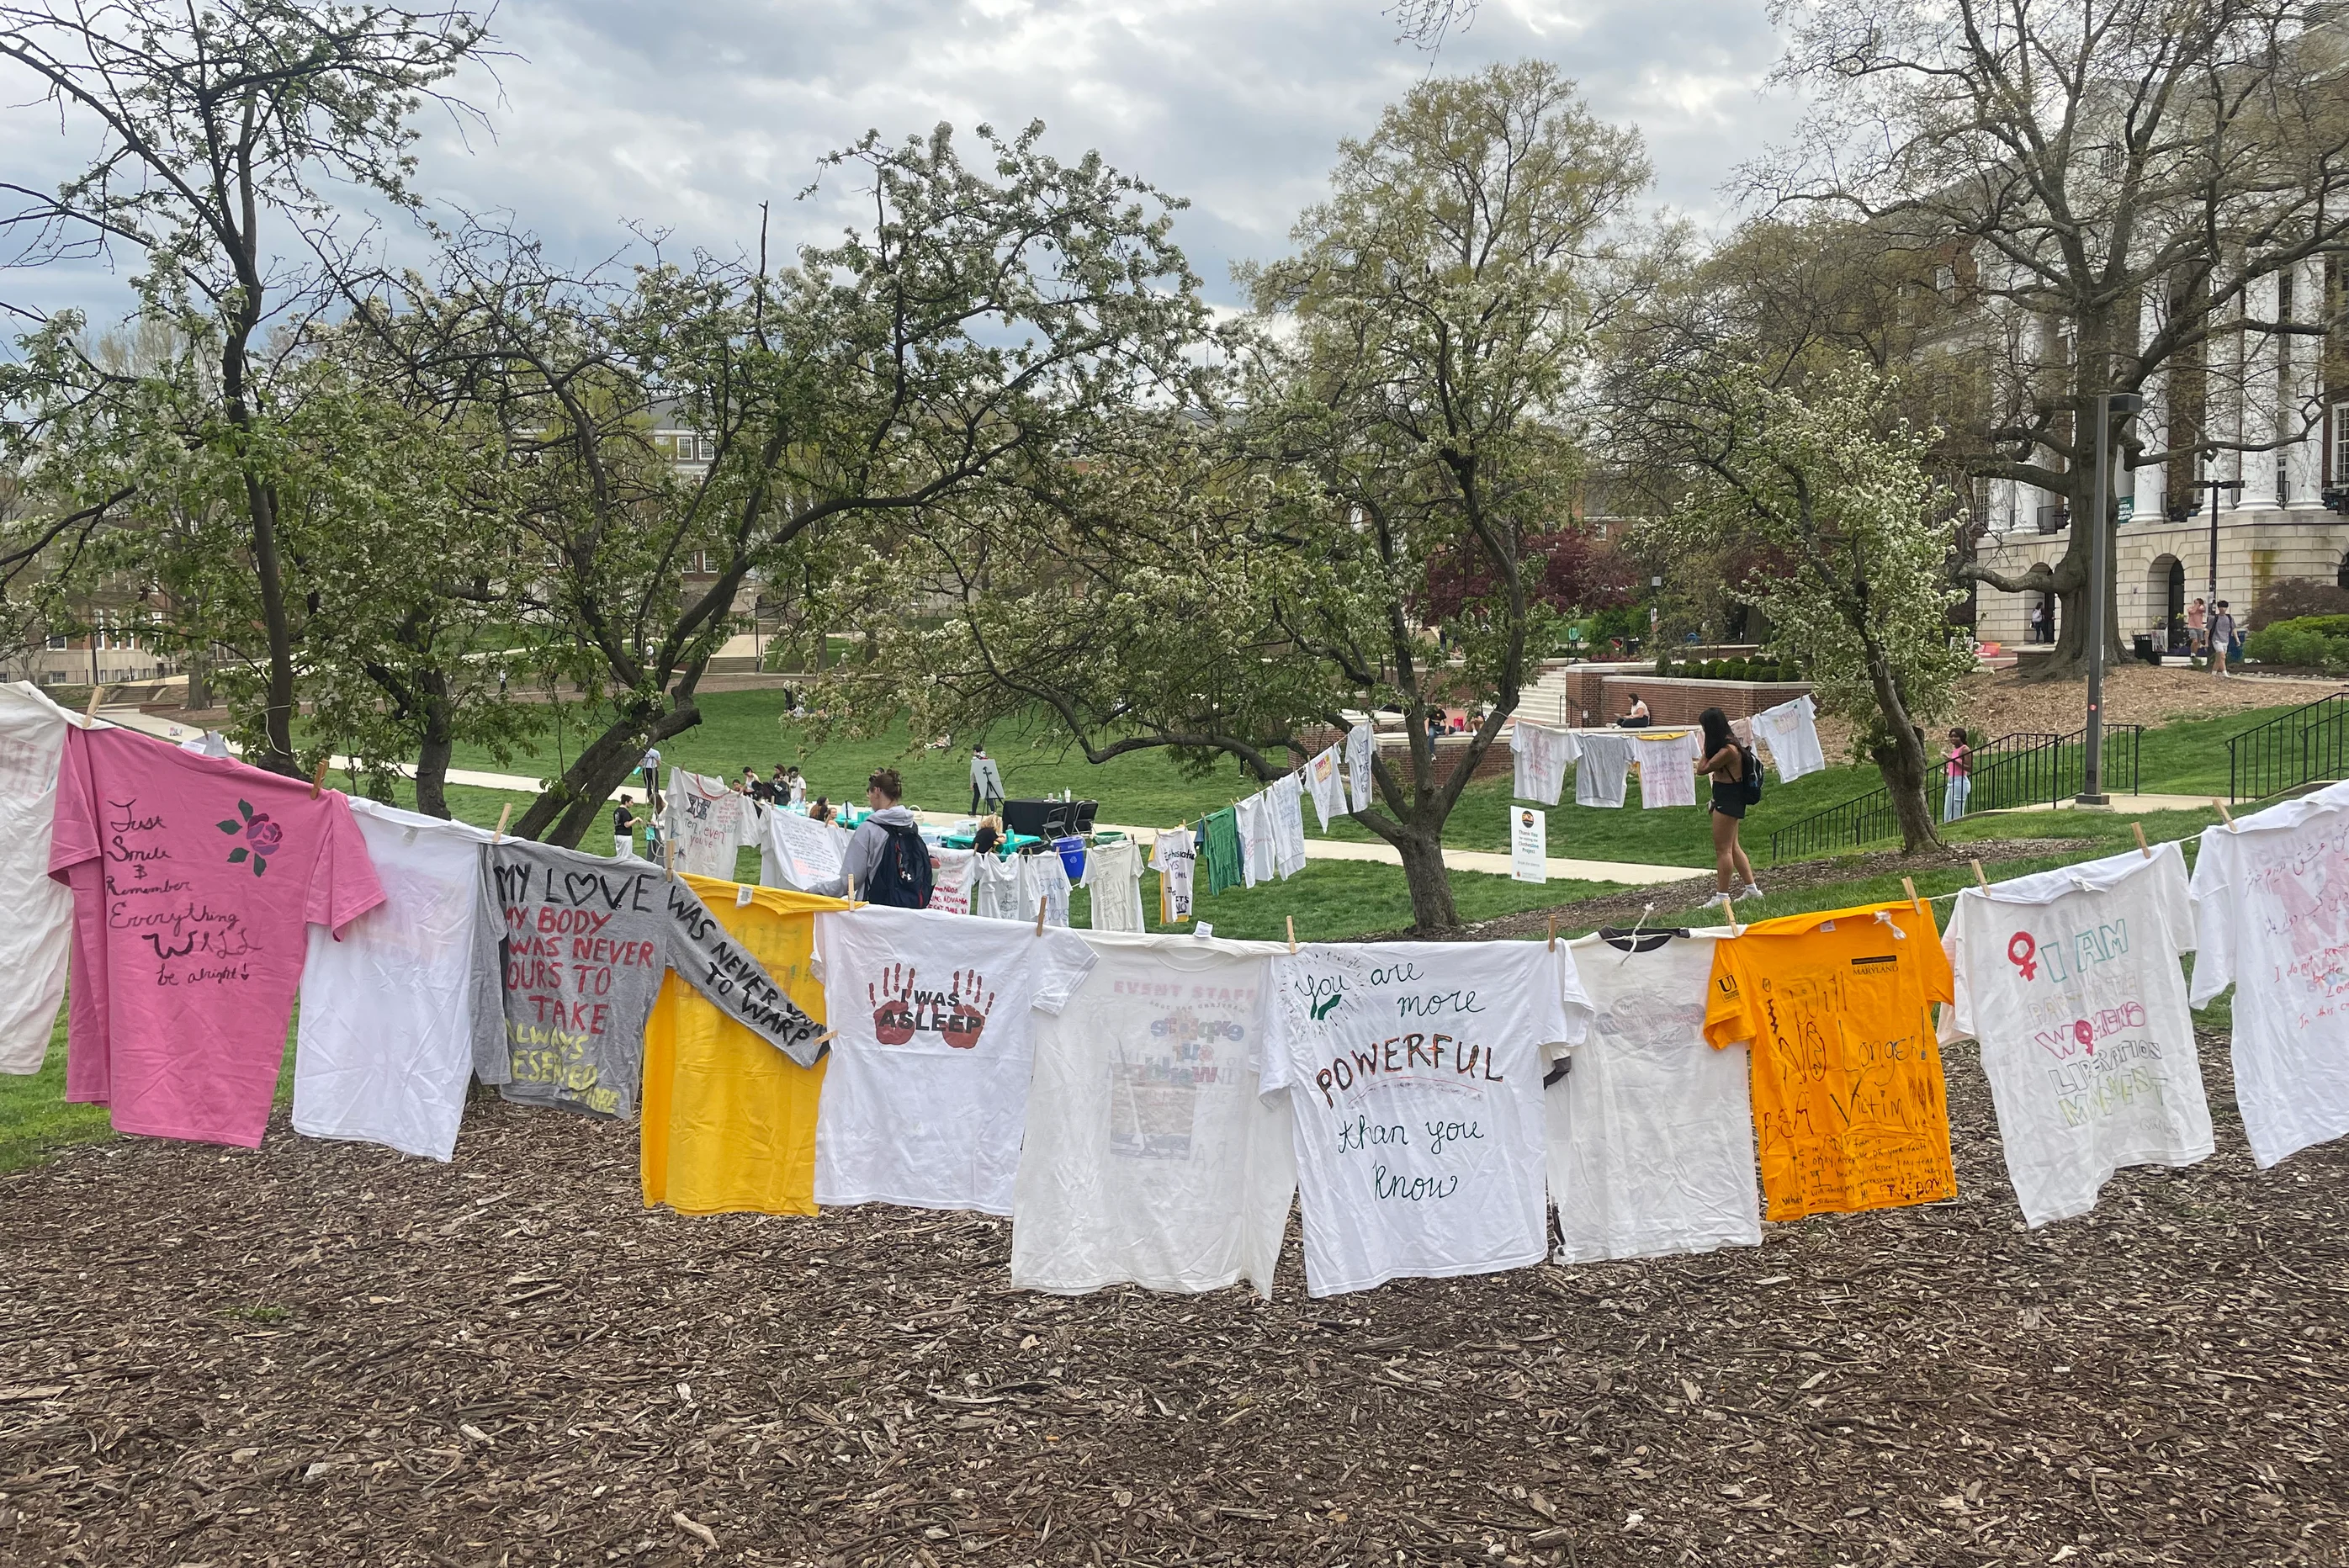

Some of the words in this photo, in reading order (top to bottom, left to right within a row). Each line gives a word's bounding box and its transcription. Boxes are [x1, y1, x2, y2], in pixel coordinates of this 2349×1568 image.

[106, 875, 194, 897] Remember
[109, 902, 241, 937] Everything
[537, 905, 613, 936] BODY
[507, 935, 564, 958] WAS
[572, 937, 655, 968] NEVER
[666, 885, 717, 942] WAS
[710, 940, 779, 1007] NEVER
[2075, 918, 2129, 973] AM
[156, 962, 180, 987] be
[573, 964, 612, 996] TO
[705, 961, 734, 996] TO
[1371, 962, 1424, 987] are
[1853, 965, 1899, 976] MARYLAND
[901, 988, 907, 1004] I
[914, 989, 960, 1008] WAS
[1113, 979, 1183, 997] EVENT
[1191, 985, 1257, 1002] STAFF
[1397, 990, 1487, 1018] more
[528, 995, 610, 1035] TAKE
[878, 1009, 982, 1035] ASLEEP
[1315, 1032, 1504, 1110] POWERFUL
[2048, 1039, 2163, 1096] LIBERATION
[1338, 1115, 1409, 1154] than
[1424, 1120, 1485, 1155] you
